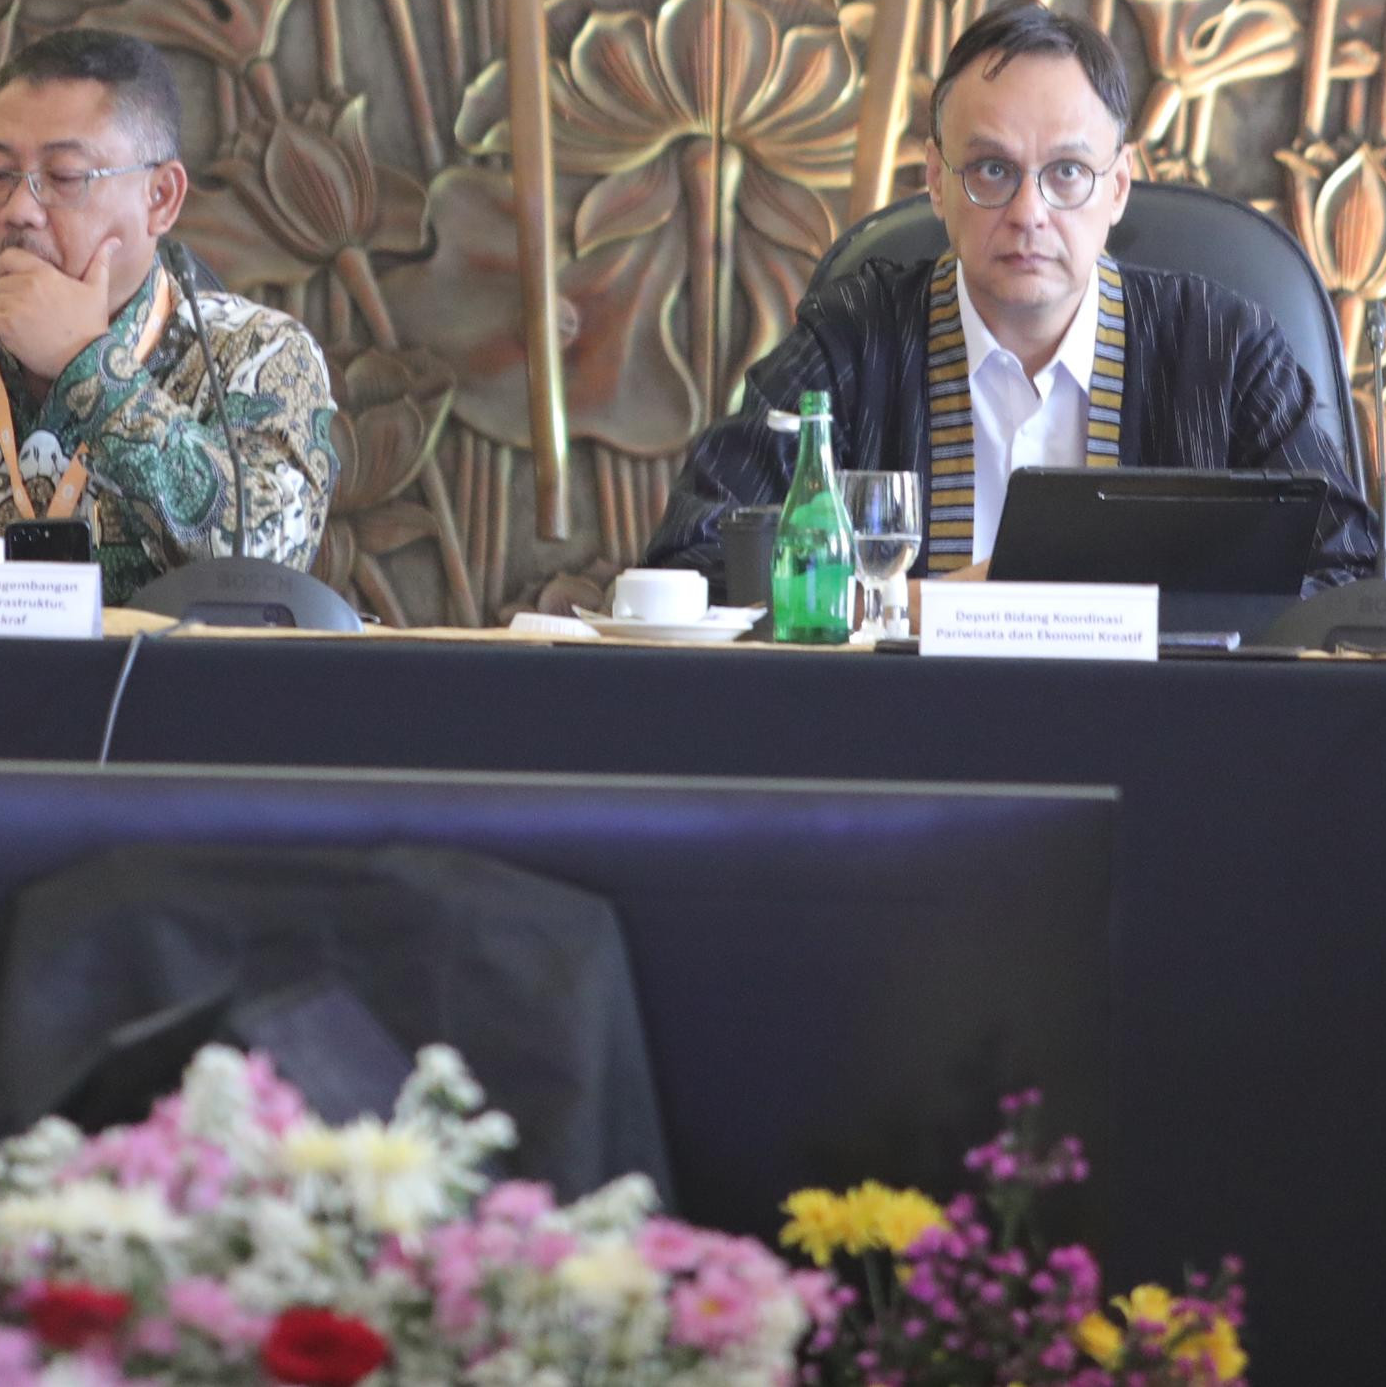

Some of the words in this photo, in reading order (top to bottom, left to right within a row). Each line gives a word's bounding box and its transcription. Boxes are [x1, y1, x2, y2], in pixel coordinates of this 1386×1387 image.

[955, 611, 1000, 624] Deputi
[1004, 611, 1049, 625] Bidang
[1053, 612, 1124, 624] Koordinasi
[936, 628, 1004, 640] Pariwisata
[1008, 629, 1033, 640] dan
[1037, 630, 1094, 642] Ekonomi
[1098, 631, 1143, 643] Kreatif
